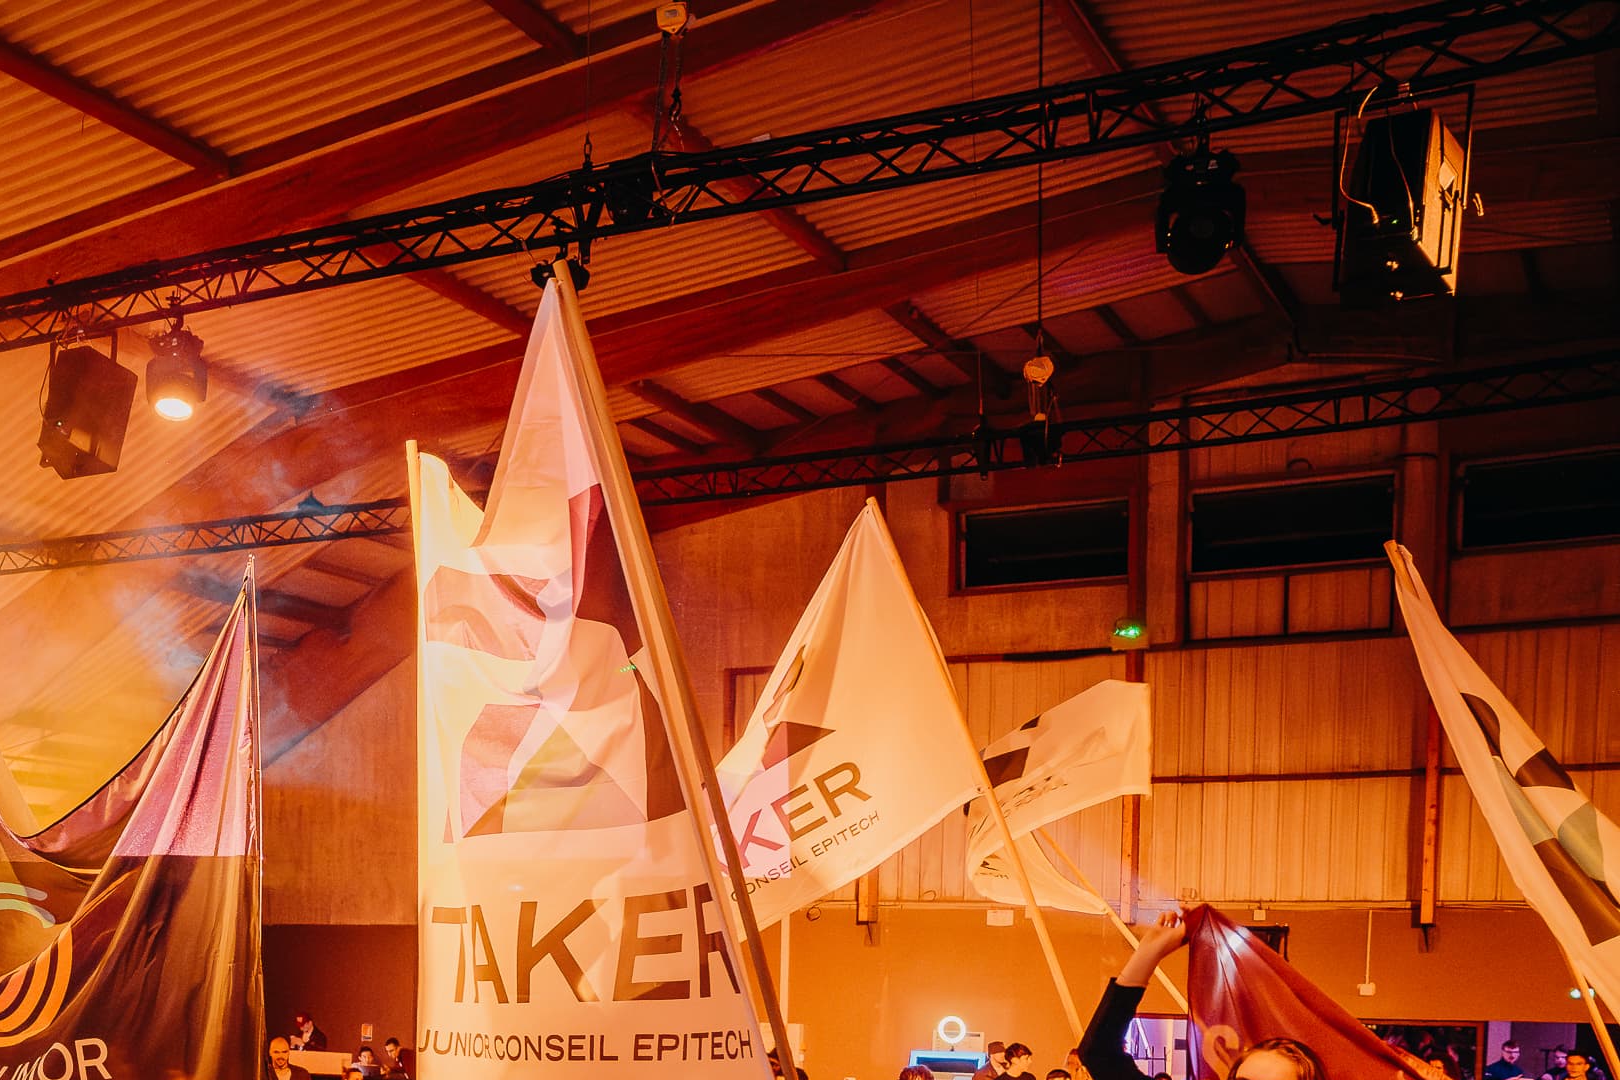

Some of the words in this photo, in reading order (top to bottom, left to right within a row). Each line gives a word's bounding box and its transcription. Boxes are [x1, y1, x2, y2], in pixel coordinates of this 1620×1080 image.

[718, 762, 872, 874] KER
[811, 810, 880, 857] EPITECH
[432, 882, 741, 1004] TAKER
[418, 1029, 491, 1059] JUNIOR
[494, 1034, 619, 1062] CONSEIL
[633, 1029, 754, 1062] EPITECH
